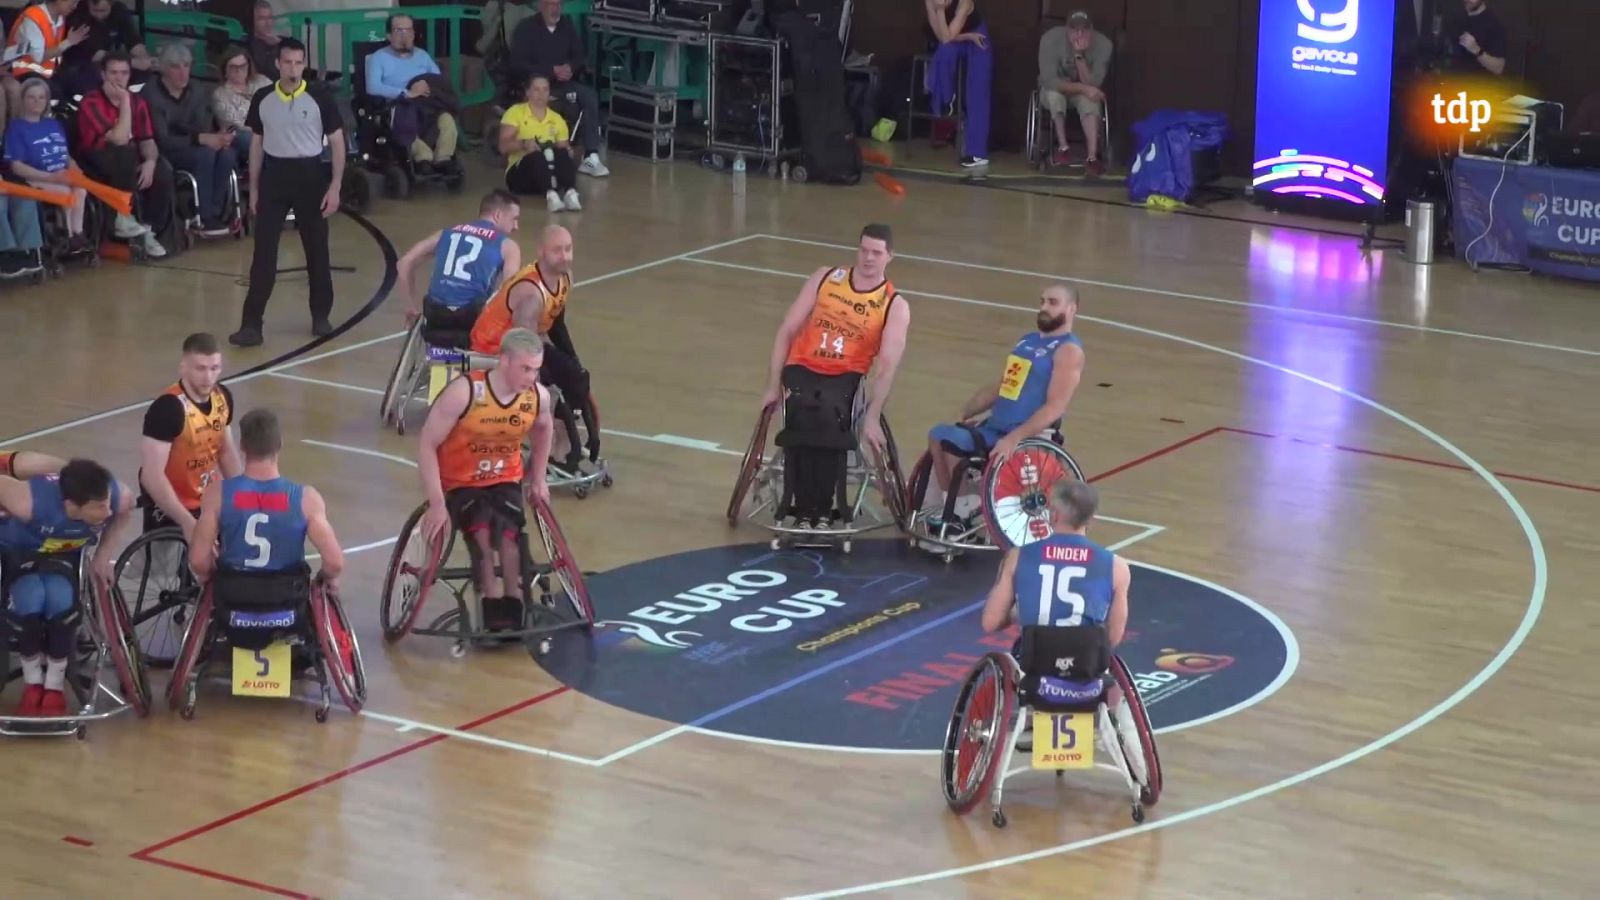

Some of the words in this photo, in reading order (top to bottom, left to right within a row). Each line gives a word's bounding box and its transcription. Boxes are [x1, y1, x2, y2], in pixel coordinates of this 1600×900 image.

[443, 232, 483, 281] 12
[820, 332, 845, 353] 14
[244, 512, 271, 568] 5
[1045, 545, 1089, 562] LINDEN
[628, 569, 787, 625] EURO
[730, 588, 846, 633] CUP
[1038, 564, 1087, 627] 15
[253, 681, 280, 689] LOTTO
[1050, 714, 1076, 749] 15
[1053, 753, 1082, 762] LOTTO
